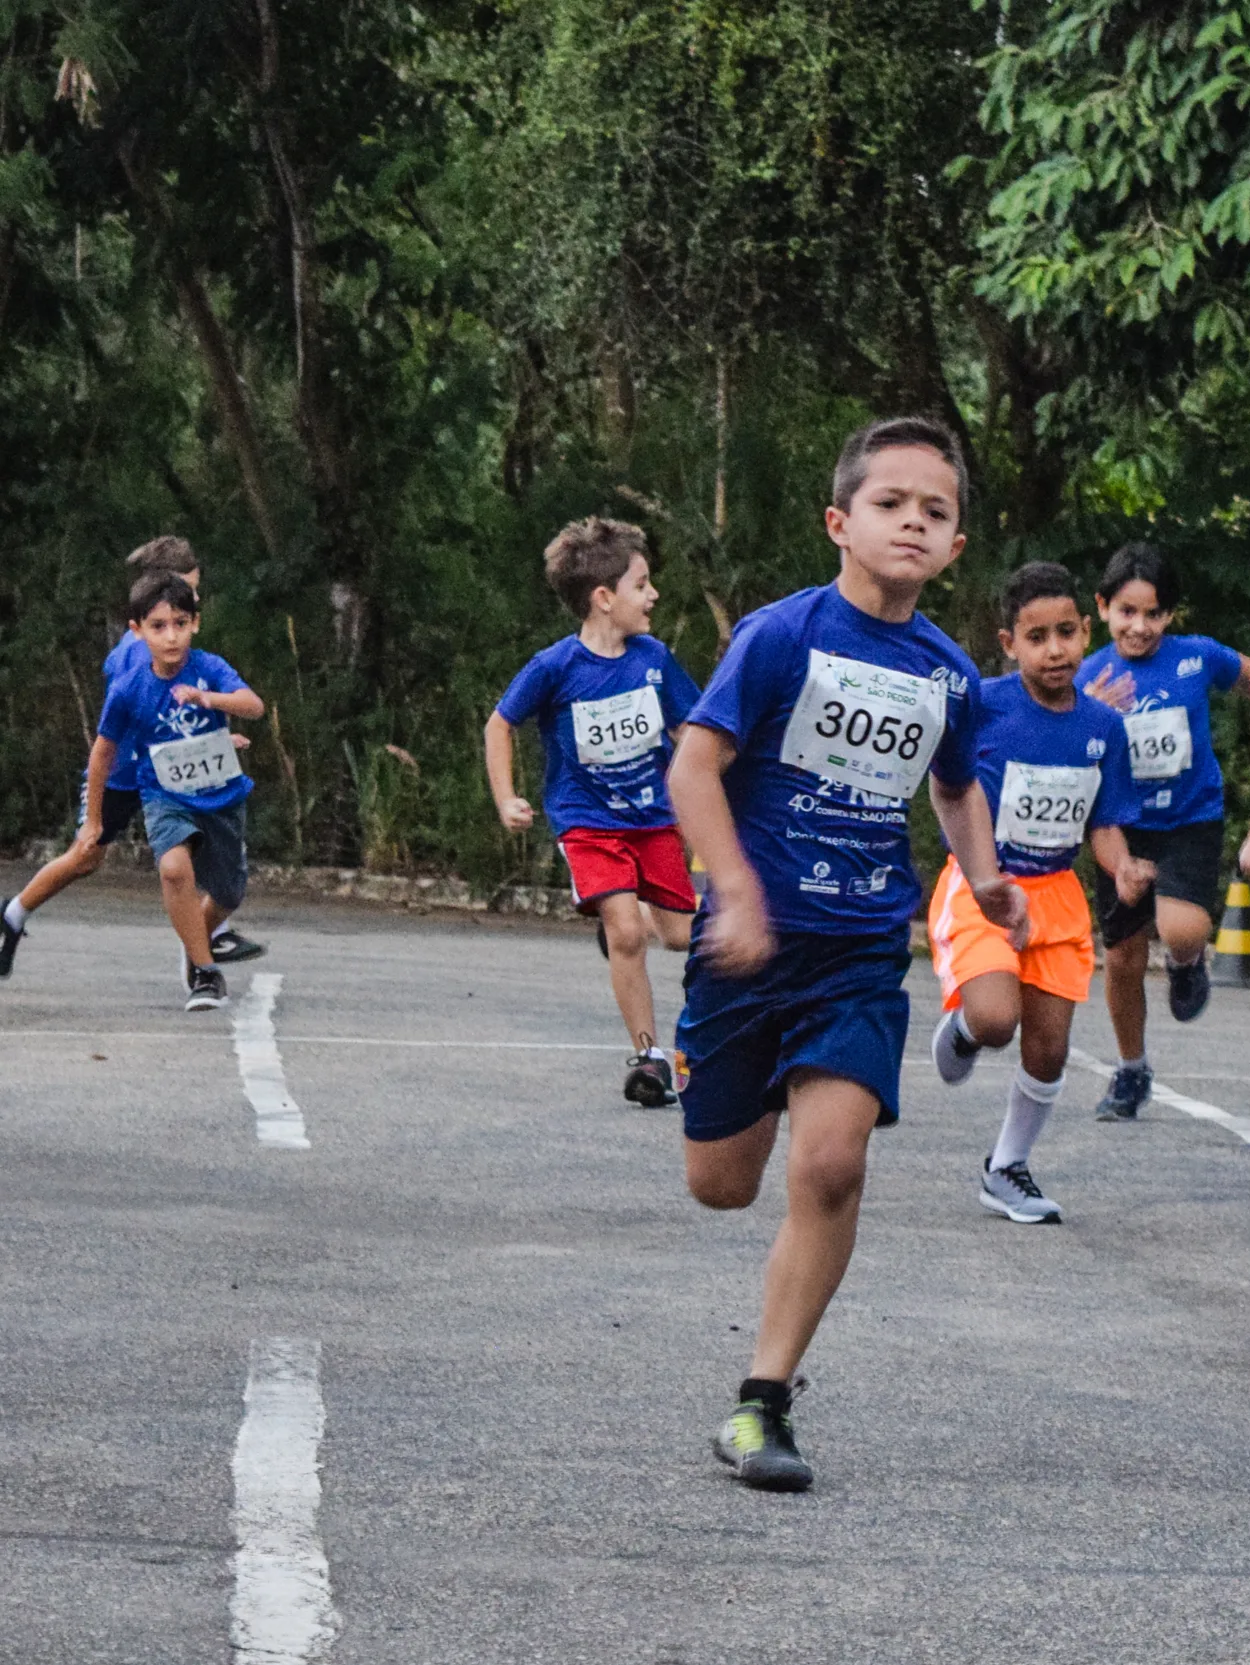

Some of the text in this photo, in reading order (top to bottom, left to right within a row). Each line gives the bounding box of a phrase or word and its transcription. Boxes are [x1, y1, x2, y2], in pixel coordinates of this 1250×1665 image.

[588, 714, 649, 745] 3156
[815, 701, 924, 760] 3058
[1130, 734, 1177, 760] 136
[169, 754, 225, 782] 3217
[1015, 796, 1086, 823] 3226
